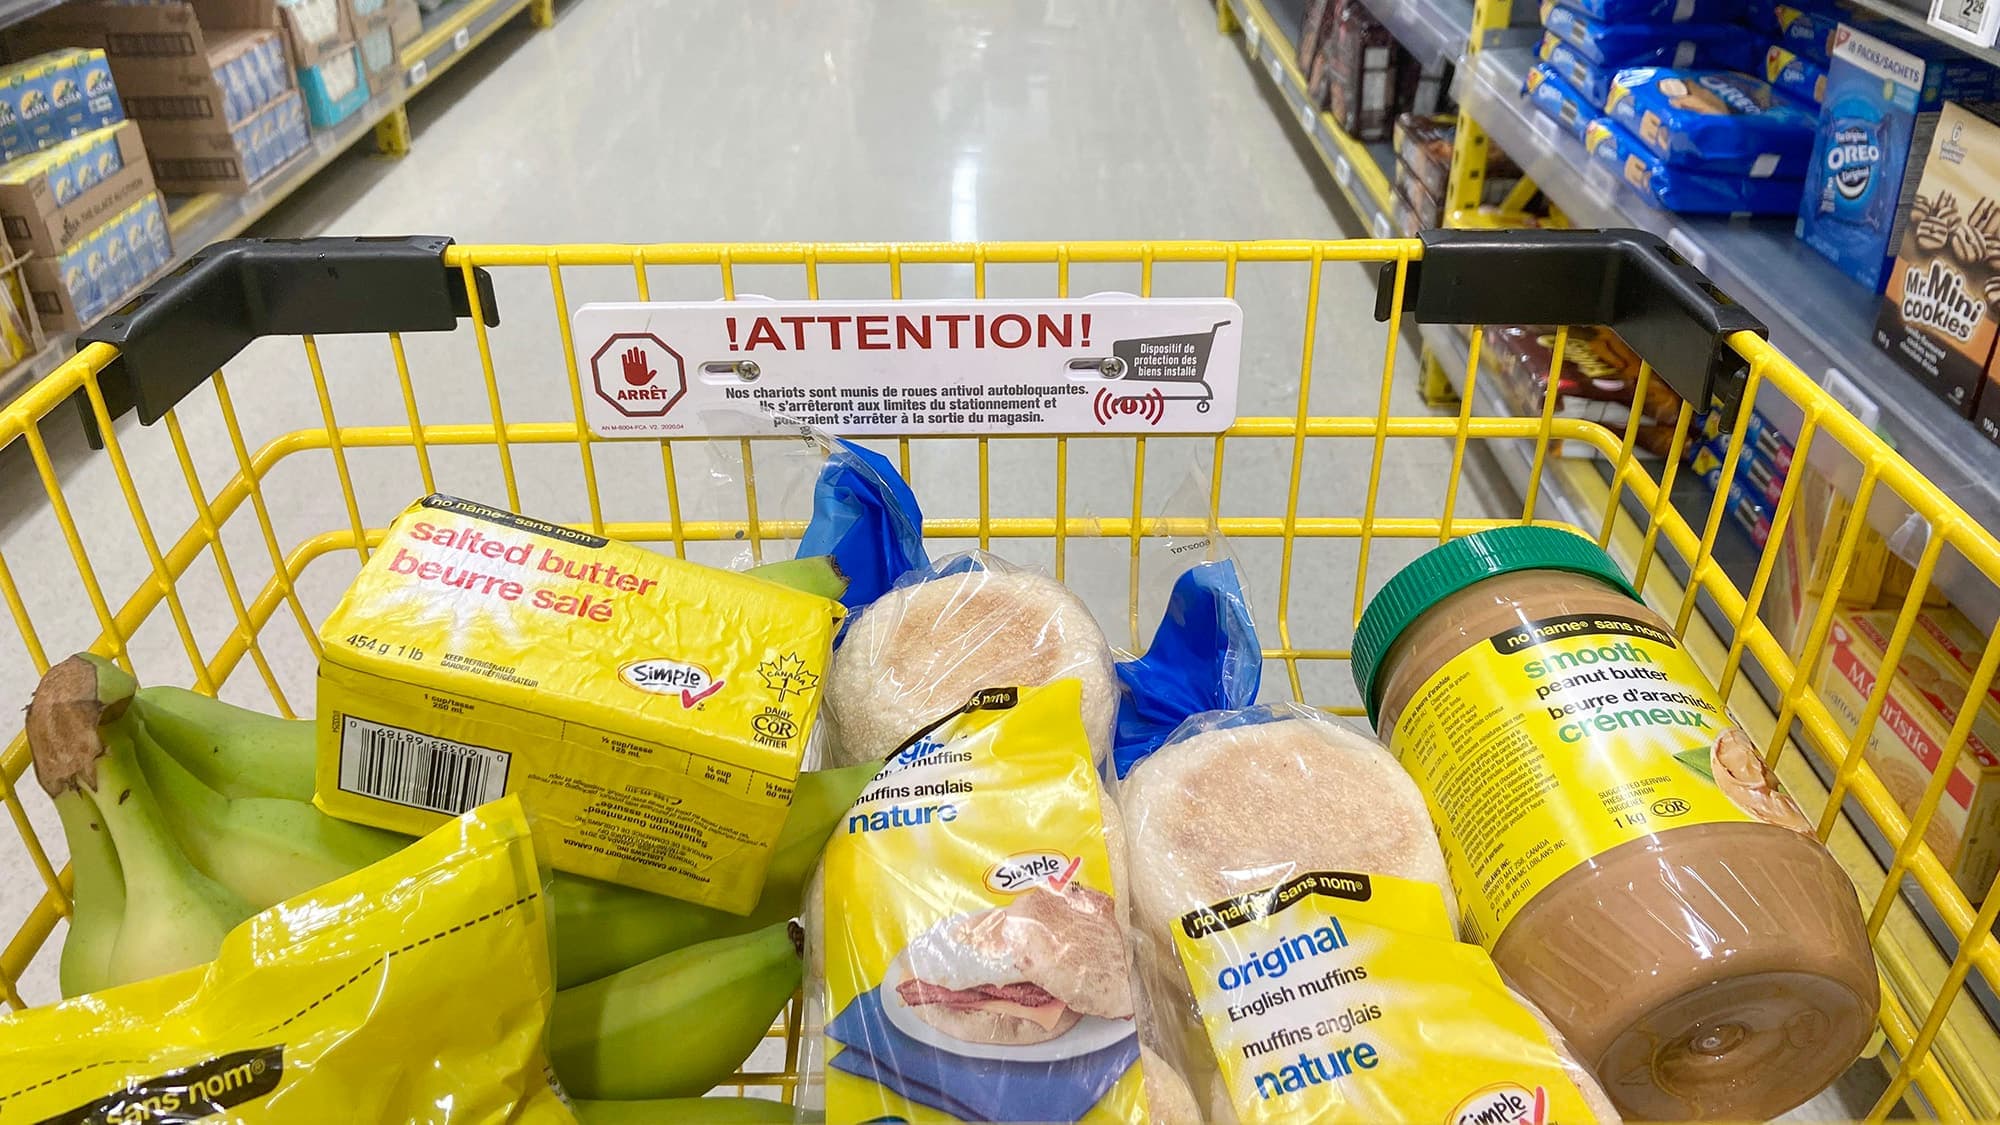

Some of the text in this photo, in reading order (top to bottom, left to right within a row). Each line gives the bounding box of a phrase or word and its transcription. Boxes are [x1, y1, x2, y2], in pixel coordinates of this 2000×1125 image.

[1856, 44, 1920, 83] PACKS/SACHETS
[1828, 144, 1879, 170] OREO
[1906, 264, 1982, 322] Mr. Mini
[1904, 299, 1970, 339] cookies
[725, 313, 1092, 352] !ATTENTION!
[1140, 343, 1195, 355] Dispositif de
[1134, 355, 1197, 367] protection des
[1138, 366, 1197, 377] biens installé
[617, 385, 668, 401] ARRÊT
[726, 383, 1089, 399] Nos chariots sont munis de roues antivol autobloquantes.
[778, 398, 854, 413] s'arrêteront
[858, 400, 882, 412] aux
[884, 398, 926, 411] limites
[930, 399, 946, 411] du
[949, 398, 1041, 410] stationnement
[1044, 397, 1057, 409] et
[773, 411, 1045, 427] pourraient s'arrêter à la sortie du magasin.
[431, 496, 453, 507] no
[514, 516, 553, 533] sans
[409, 520, 657, 596] salted butter
[388, 549, 614, 622] beurre salé
[1507, 633, 1530, 648] no
[1594, 619, 1633, 632] sans
[346, 634, 424, 662] 454 g 1 lb
[443, 653, 516, 674] KEEP REFRIGERATED
[1523, 641, 1653, 680] smooth
[633, 664, 701, 686] Simple
[767, 670, 806, 686] CANADA
[1536, 666, 1668, 701] peanut butter
[431, 696, 475, 710] cup/tasse
[433, 702, 464, 714] 250 mL
[765, 706, 793, 719] DAIRY
[1547, 688, 1718, 721] beurre d'arachide
[349, 720, 357, 728] 0
[754, 716, 792, 739] COR
[1558, 705, 1712, 744] crémeux
[376, 727, 424, 745] 68189
[610, 739, 653, 754] cup/tasse
[753, 733, 788, 749] LAITIER
[430, 741, 477, 757] 60383
[496, 754, 504, 762] 0
[627, 750, 640, 759] mL
[716, 768, 732, 779] cup
[717, 776, 729, 785] mL
[1639, 775, 1672, 787] SERVING
[914, 779, 973, 797] anglais
[849, 802, 958, 834] nature
[1653, 800, 1688, 815] COR
[643, 812, 703, 837] Satisfaction
[1613, 812, 1647, 829] 1 kg
[563, 838, 593, 850] CANADA
[649, 823, 708, 848] Satisfaction
[594, 846, 604, 854] DU
[1525, 838, 1550, 859] CANADA
[995, 854, 1059, 887] Simple
[1193, 914, 1215, 930] no
[1278, 876, 1317, 902] sans
[1216, 915, 1350, 992] original
[1227, 963, 1368, 1022] English muffins
[1240, 1002, 1383, 1060] muffins anglais
[1253, 1040, 1380, 1101] nature
[106, 1092, 181, 1125] sans
